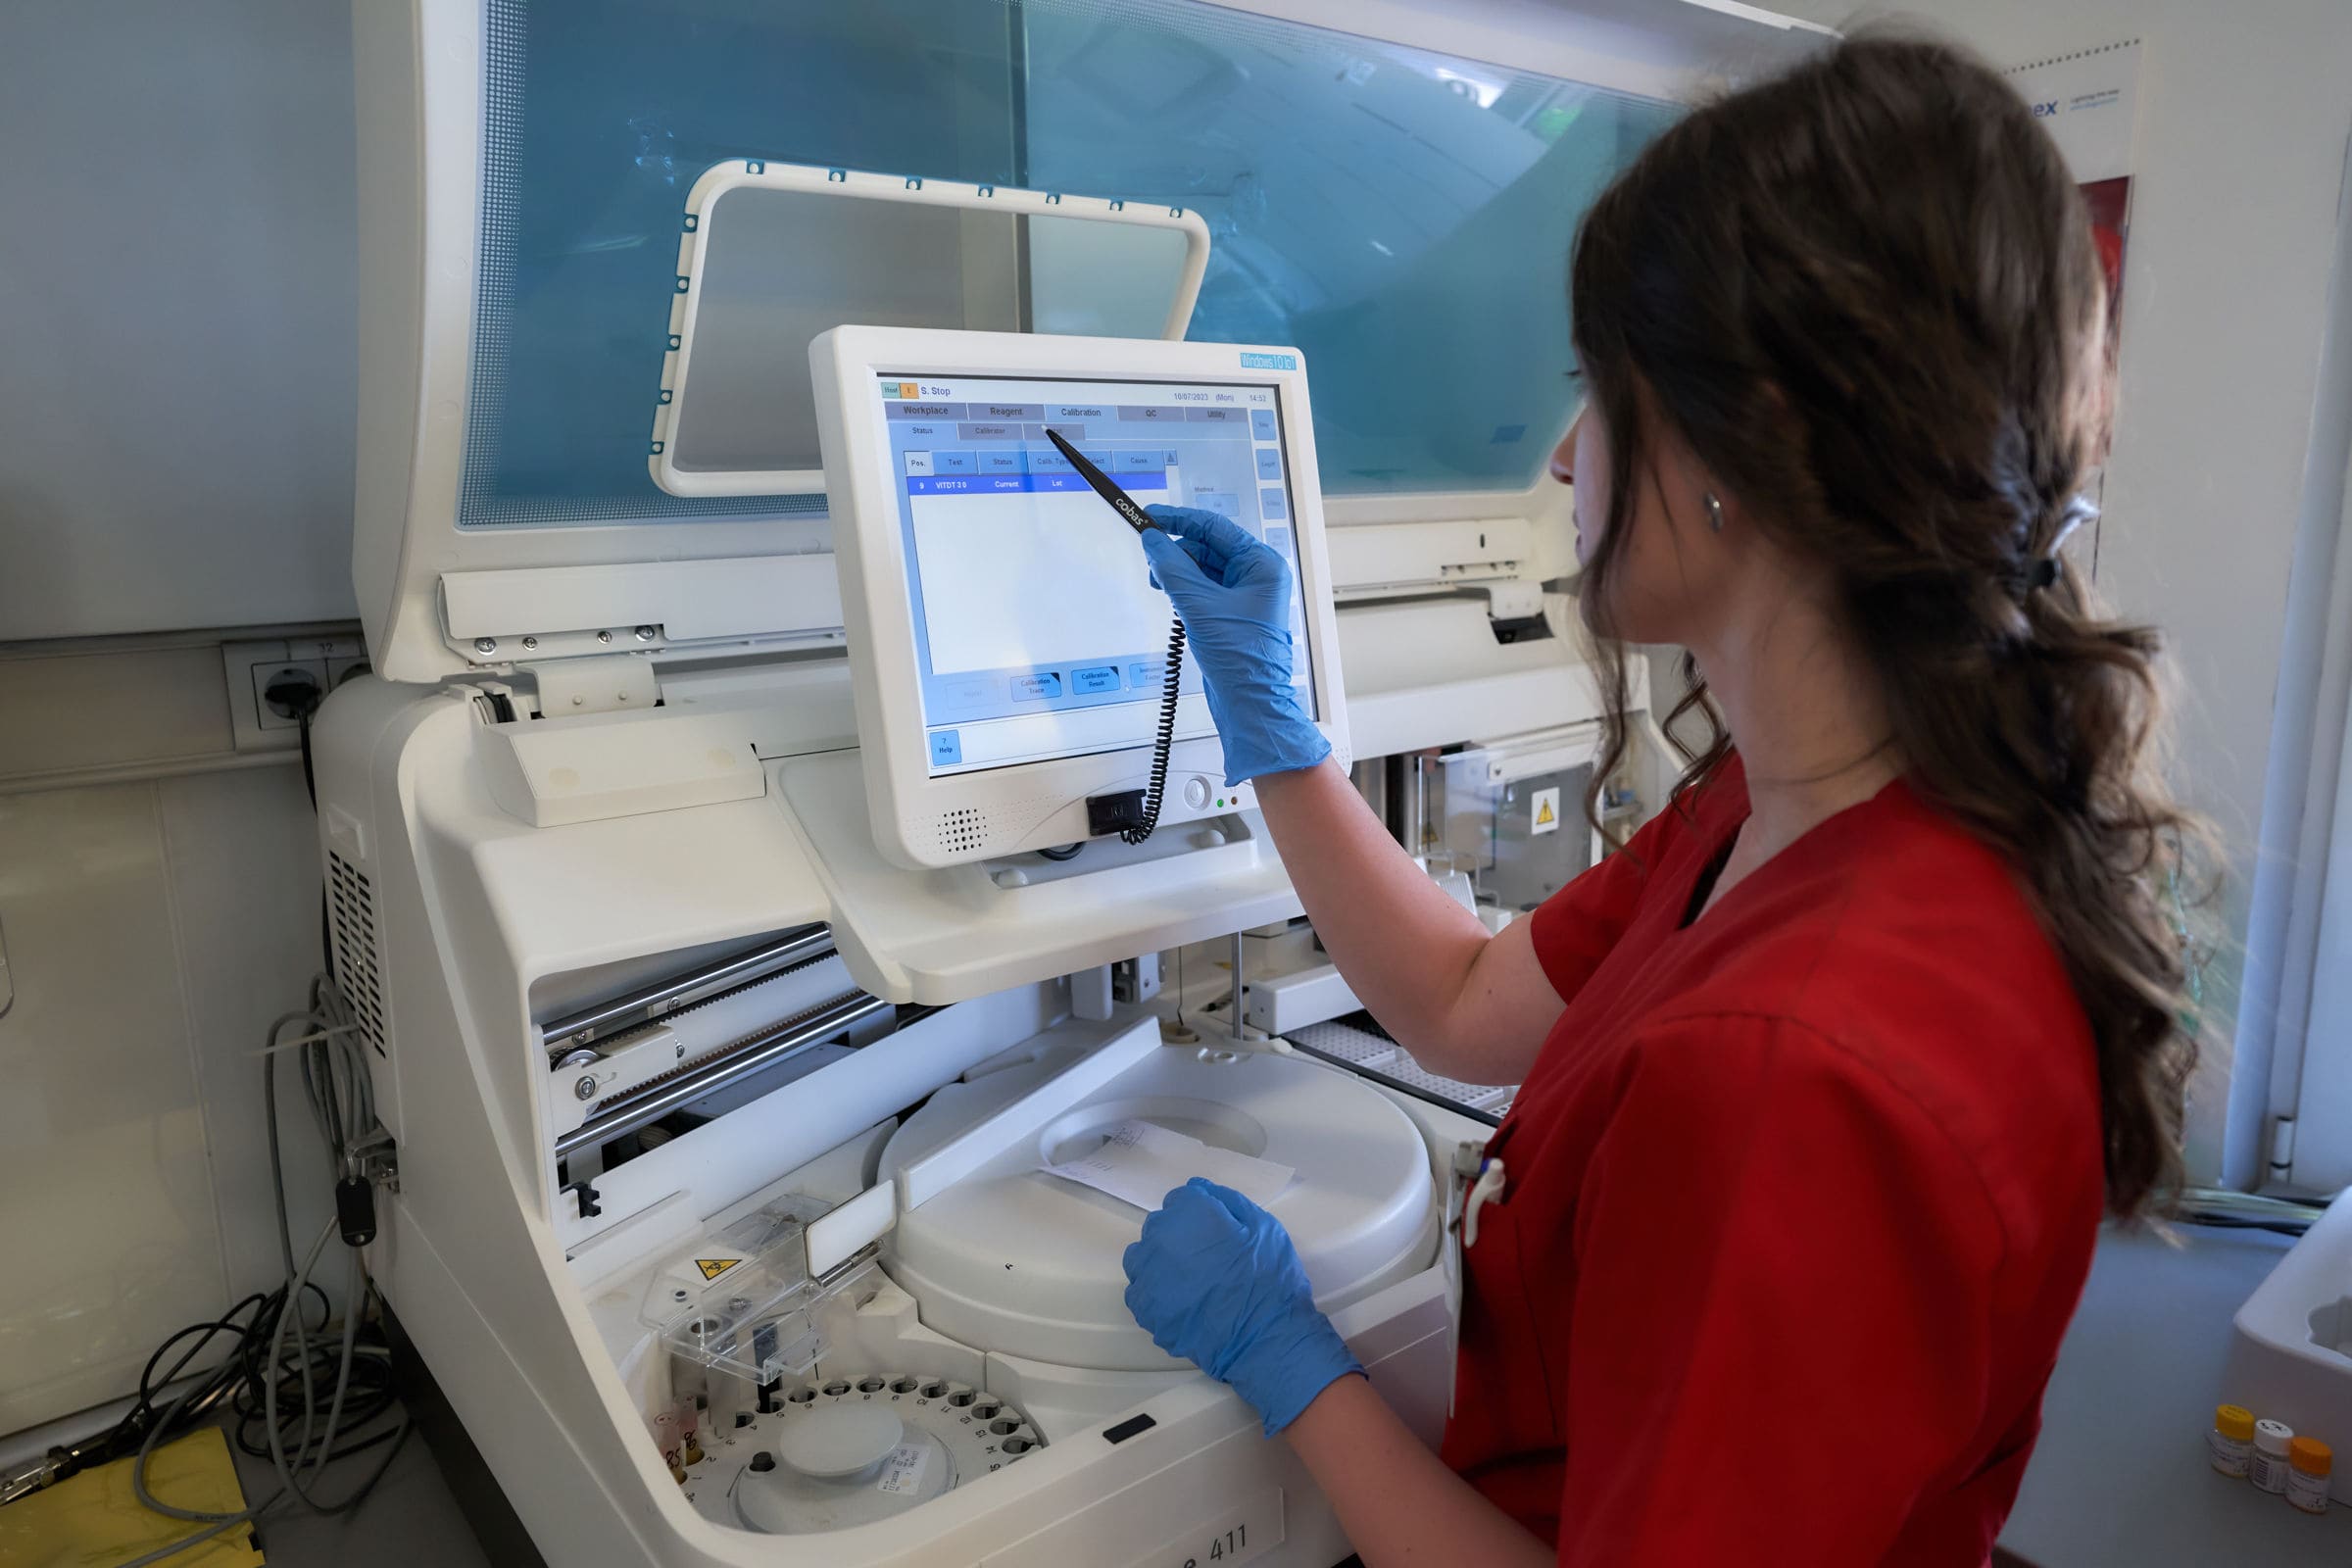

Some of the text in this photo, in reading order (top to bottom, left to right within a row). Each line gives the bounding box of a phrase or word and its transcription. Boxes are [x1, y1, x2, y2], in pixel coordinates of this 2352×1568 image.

[1241, 354, 1273, 368] Windows
[920, 386, 930, 395] S.
[932, 386, 951, 397] Stop
[904, 406, 949, 416] Workplace
[990, 408, 1023, 417] Reagent
[1061, 408, 1102, 416] Calibration
[1207, 410, 1226, 419] Utility
[911, 459, 926, 467] Pos.
[949, 458, 962, 466] Test
[1115, 498, 1144, 525] cobas
[1021, 677, 1051, 686] Calibration
[1081, 671, 1110, 680] Calibration
[1210, 1524, 1246, 1560] 411
